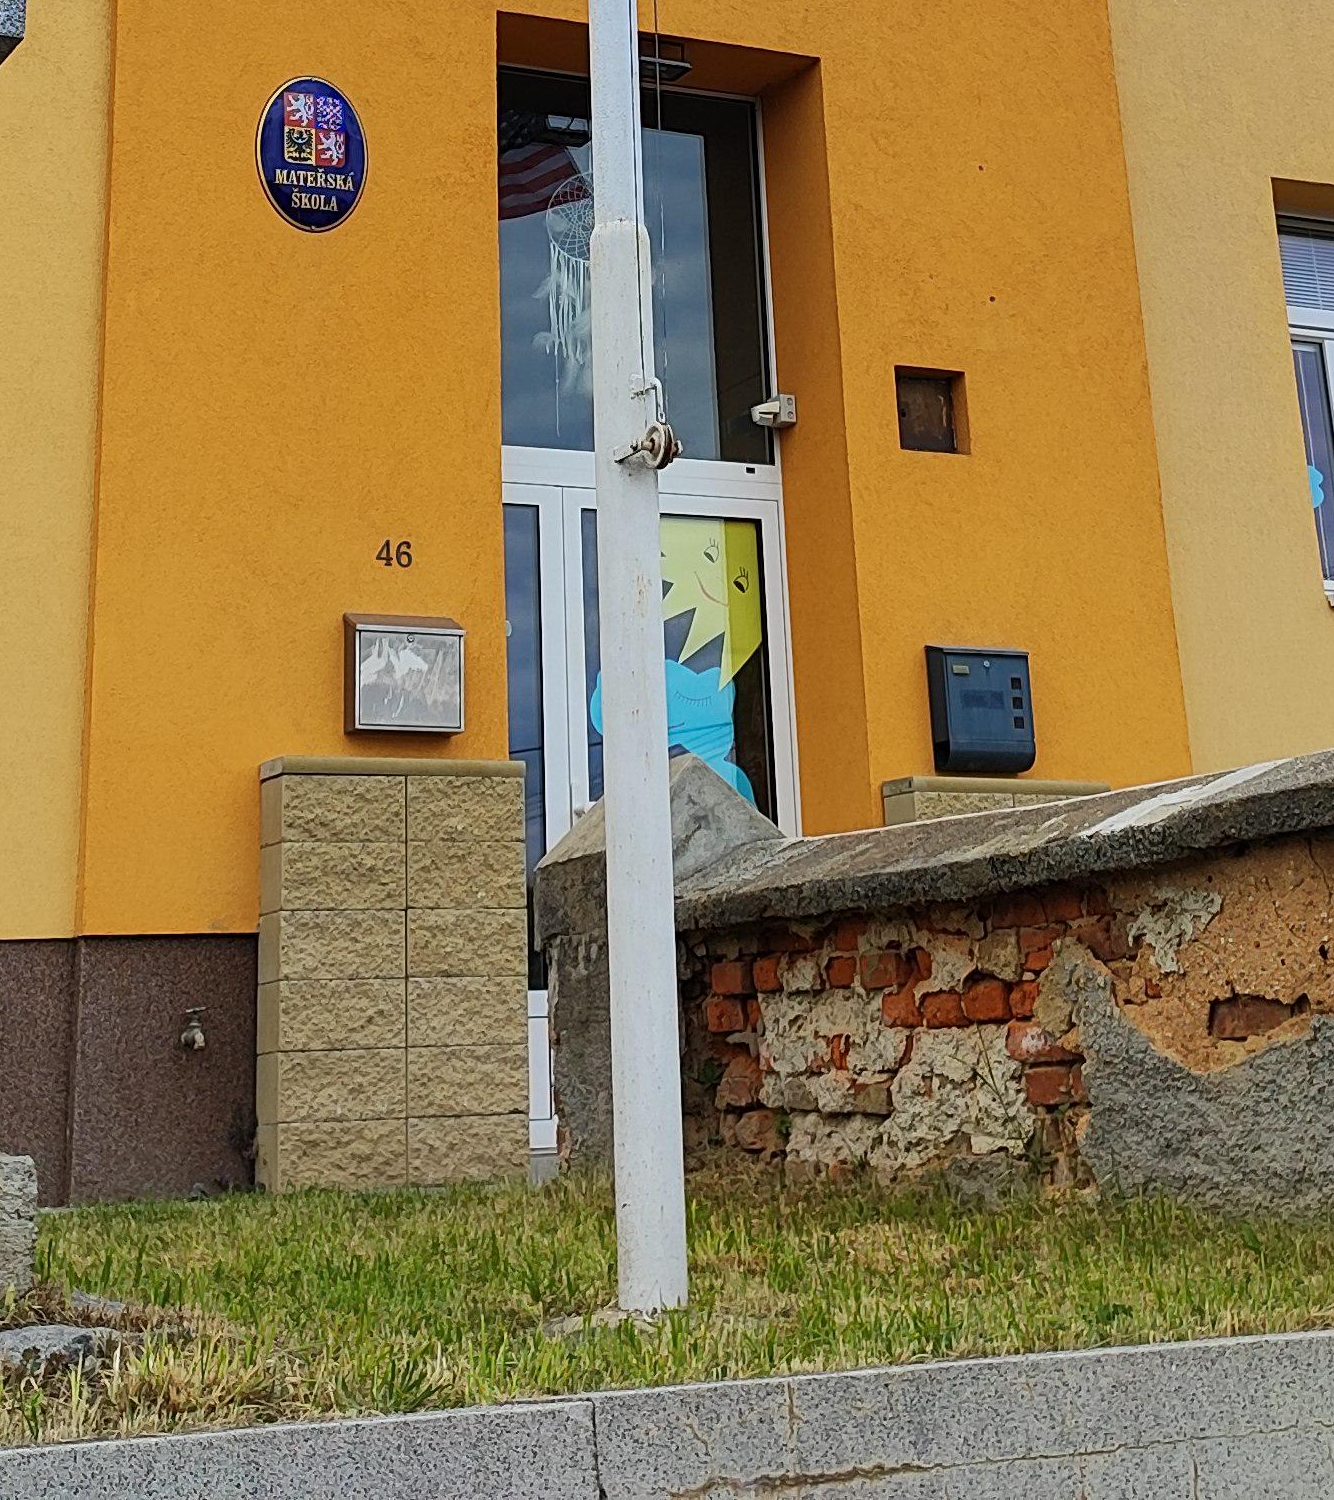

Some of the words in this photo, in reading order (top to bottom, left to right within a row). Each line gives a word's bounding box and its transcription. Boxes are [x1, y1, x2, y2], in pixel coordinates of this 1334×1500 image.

[273, 168, 355, 192] MATEŘSKÁ
[291, 187, 339, 212] ŠKOLA
[375, 539, 413, 568] 46
